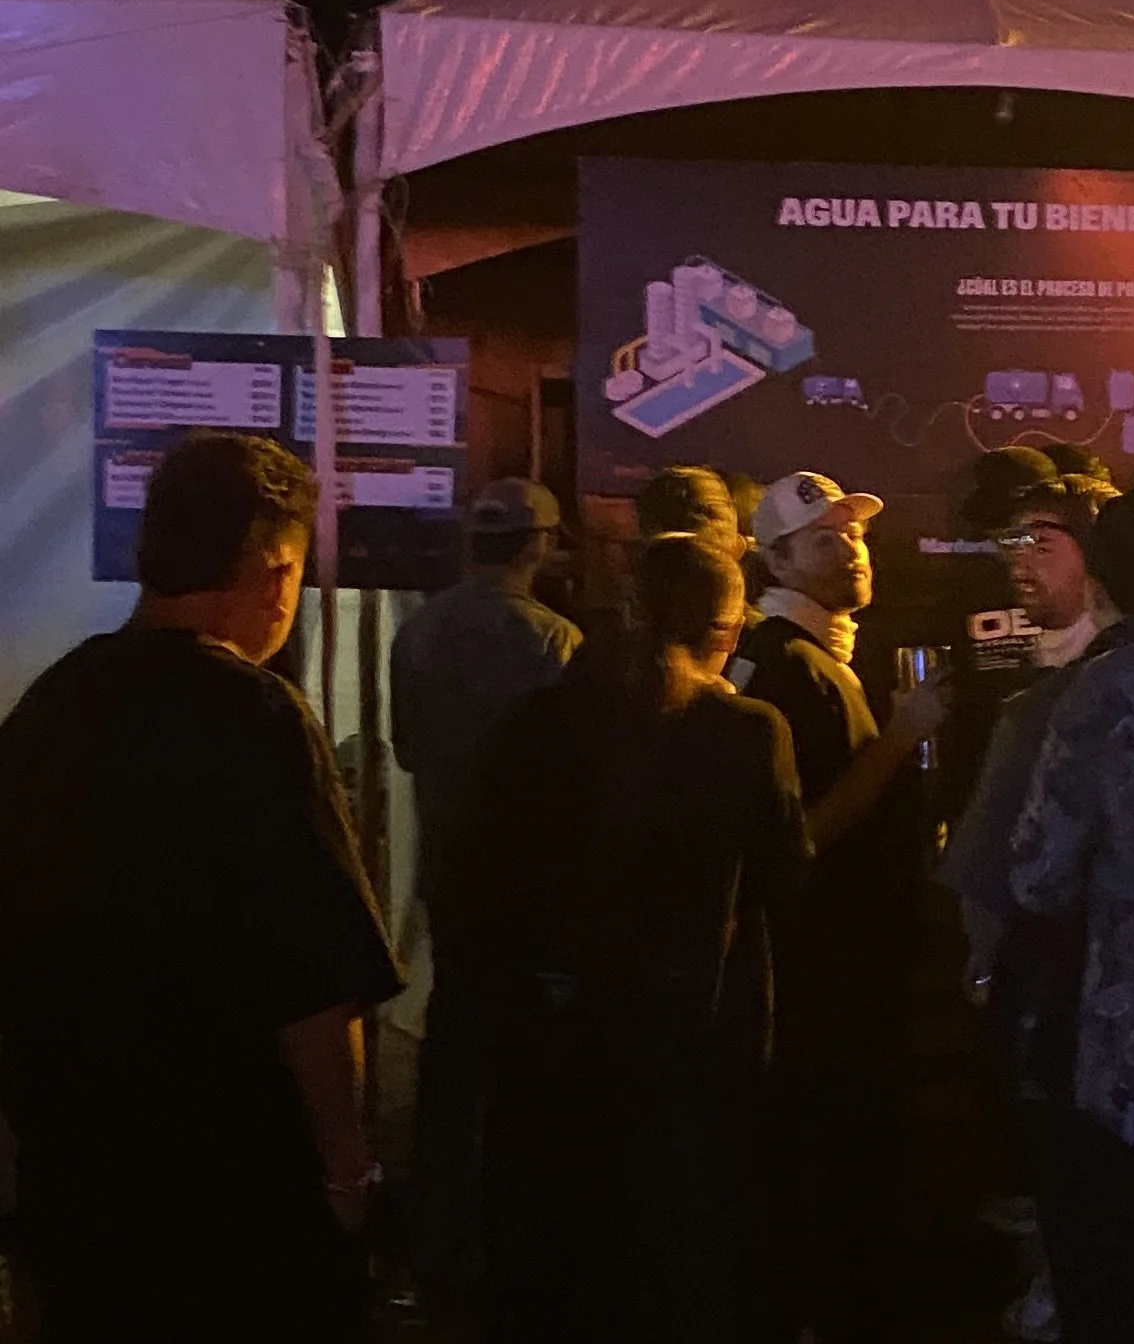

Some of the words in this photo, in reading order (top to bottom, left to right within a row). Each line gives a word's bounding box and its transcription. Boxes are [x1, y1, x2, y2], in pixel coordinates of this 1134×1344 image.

[779, 198, 882, 227] AGUA
[888, 200, 986, 229] PARA
[992, 202, 1038, 230] TU
[1001, 278, 1017, 296] ES
[1020, 279, 1034, 296] EL
[1037, 279, 1096, 297] PROCESO
[1098, 280, 1113, 297] DE
